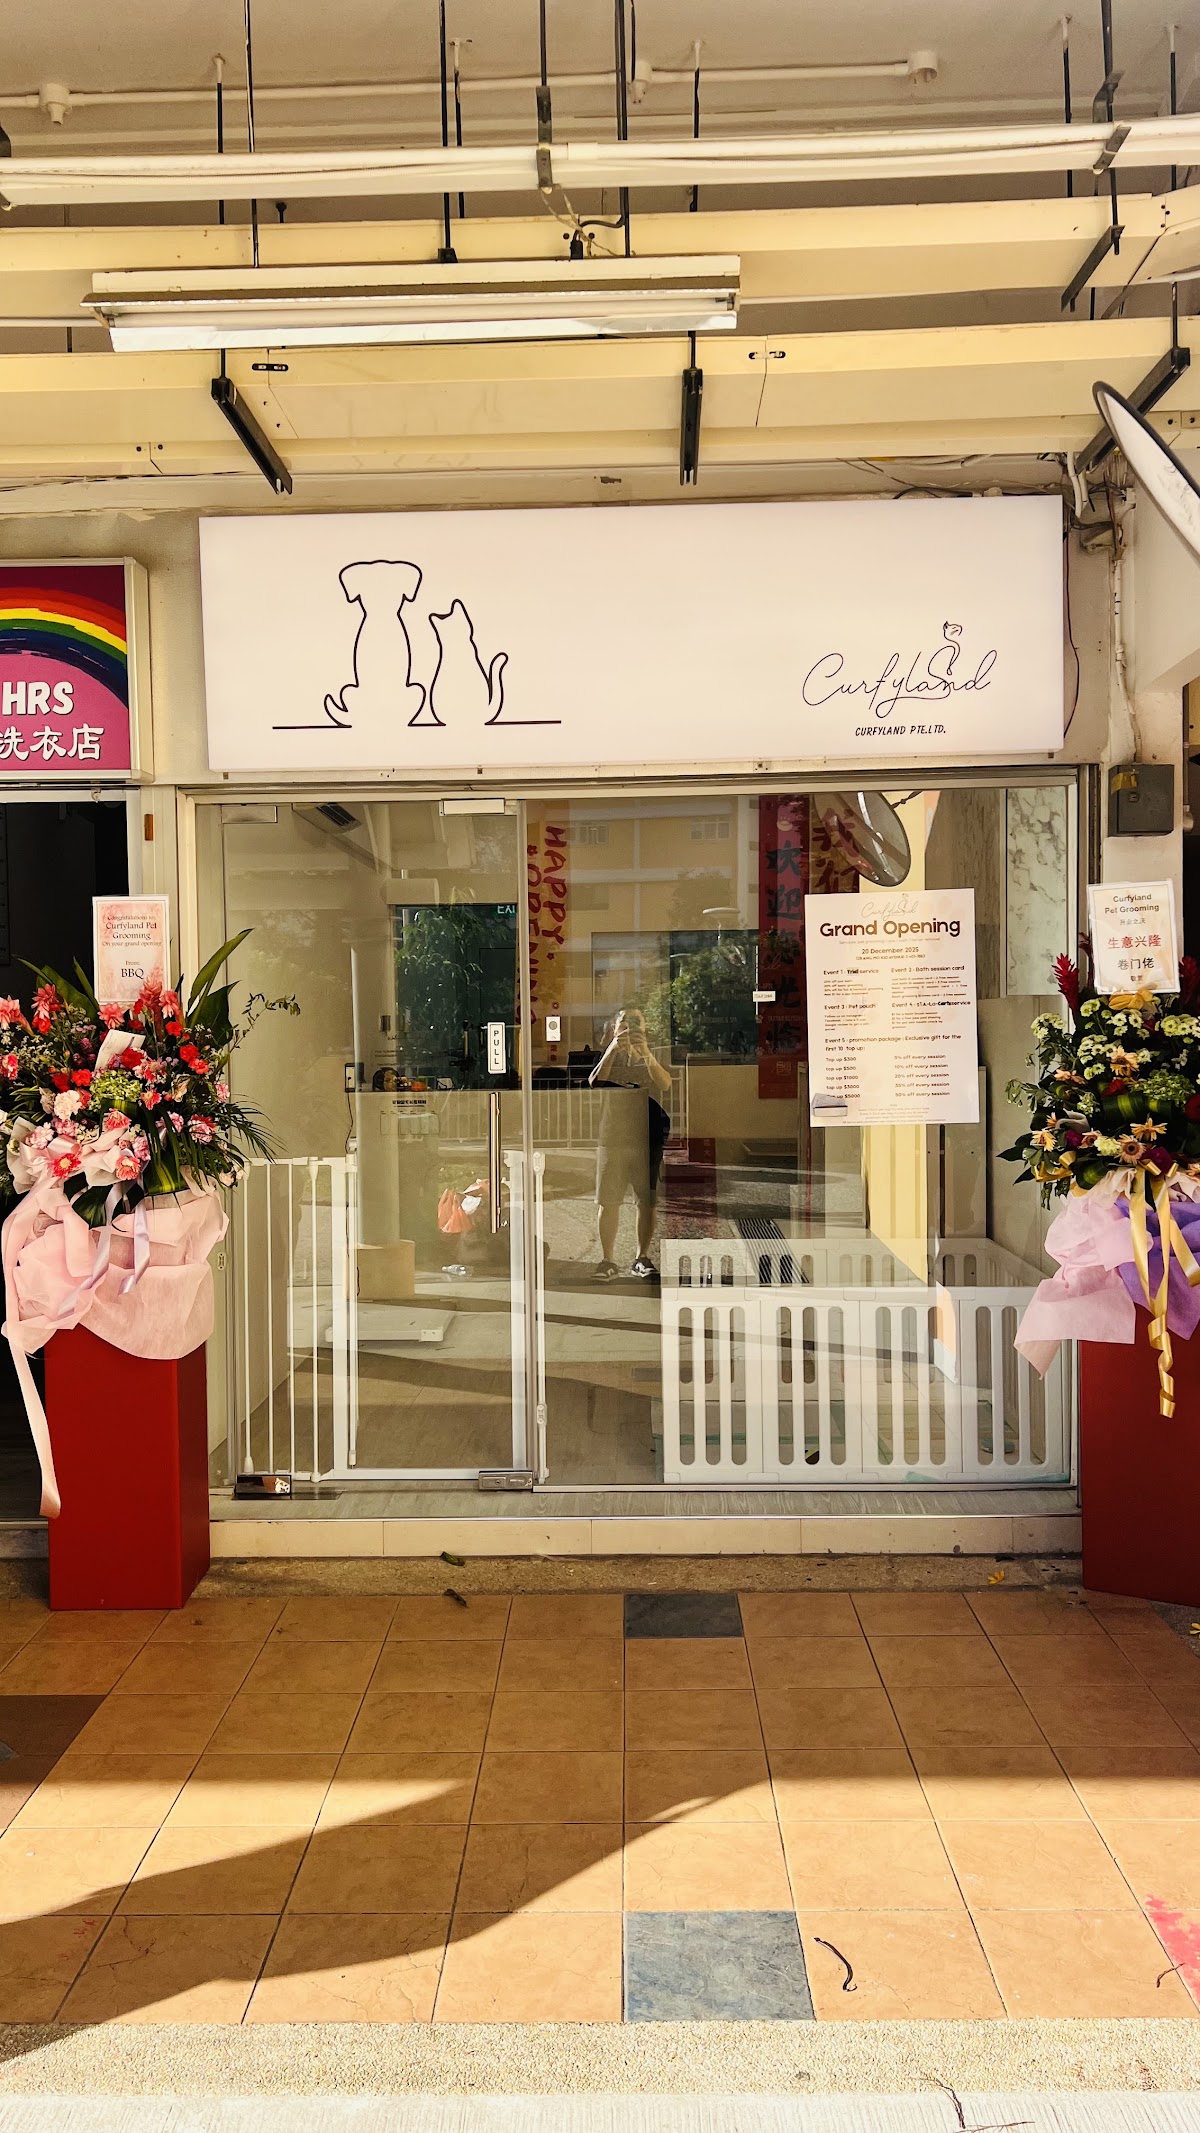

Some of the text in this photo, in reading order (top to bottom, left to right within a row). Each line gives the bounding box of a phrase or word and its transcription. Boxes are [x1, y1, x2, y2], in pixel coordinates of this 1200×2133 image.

[2, 681, 74, 716] HRS
[855, 724, 947, 737] CURFYLAND PTE.LTD.
[0, 724, 104, 761] 洗衣店
[541, 826, 567, 945] HAPPY
[1113, 894, 1152, 903] Curfyland
[497, 905, 516, 915] EXI
[1119, 904, 1160, 914] Grooming
[105, 921, 157, 931] Curfyland Pet
[819, 917, 960, 938] Grand Opening
[112, 932, 152, 941] Grooming
[1107, 934, 1162, 949] 生意兴隆
[121, 968, 145, 980] BBQ
